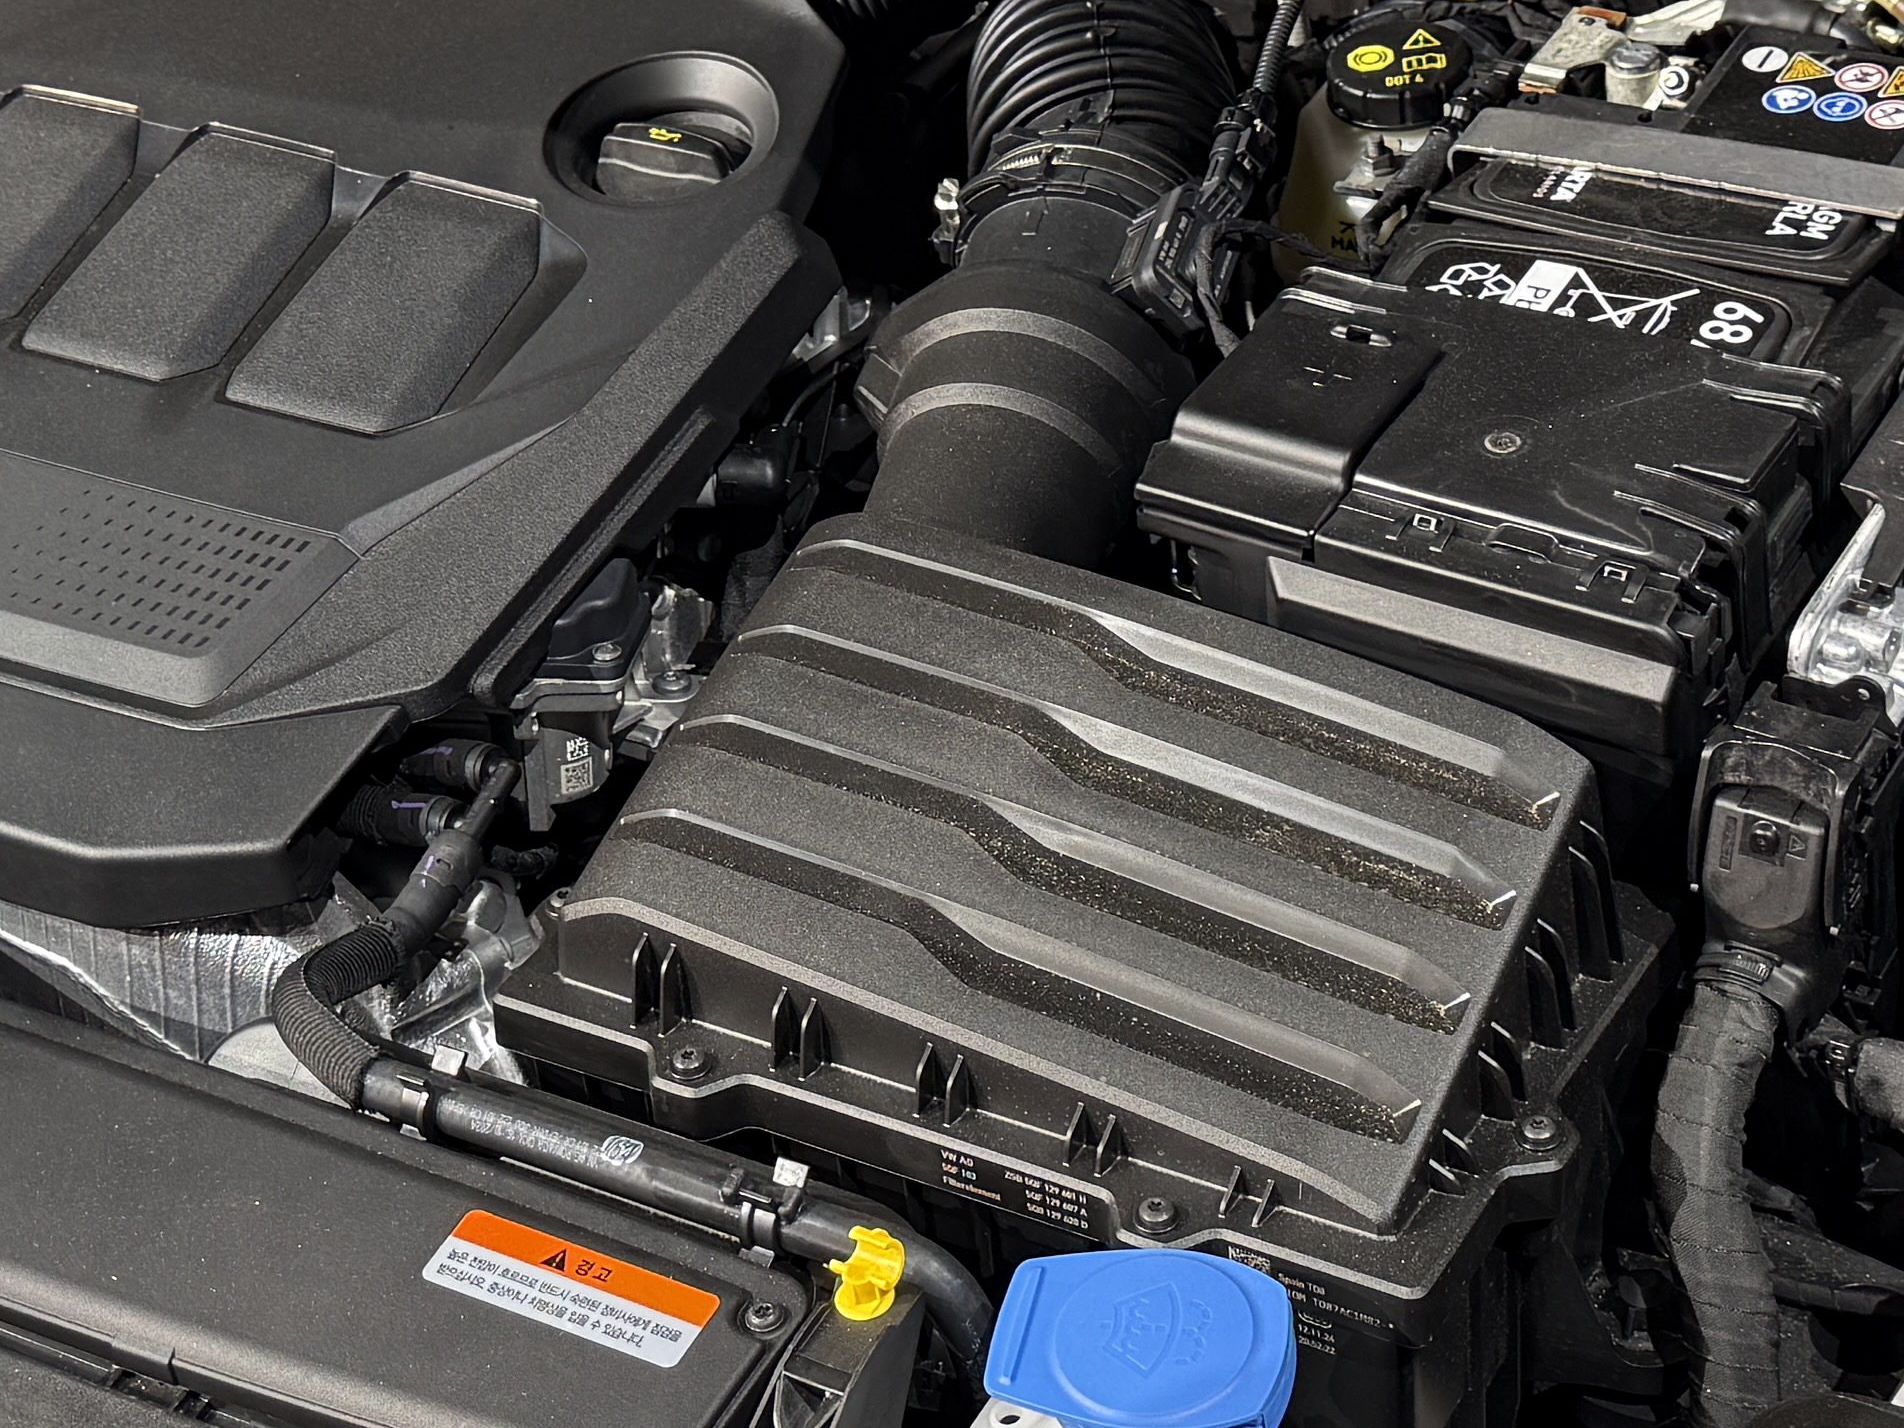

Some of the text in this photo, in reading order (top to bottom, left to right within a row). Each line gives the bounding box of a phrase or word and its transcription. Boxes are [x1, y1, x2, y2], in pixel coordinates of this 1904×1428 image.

[1385, 75, 1412, 88] DOT
[1799, 206, 1844, 240] GM
[572, 1257, 615, 1285] 경고
[535, 1279, 572, 1302] 반드시
[587, 1318, 603, 1331] 수
